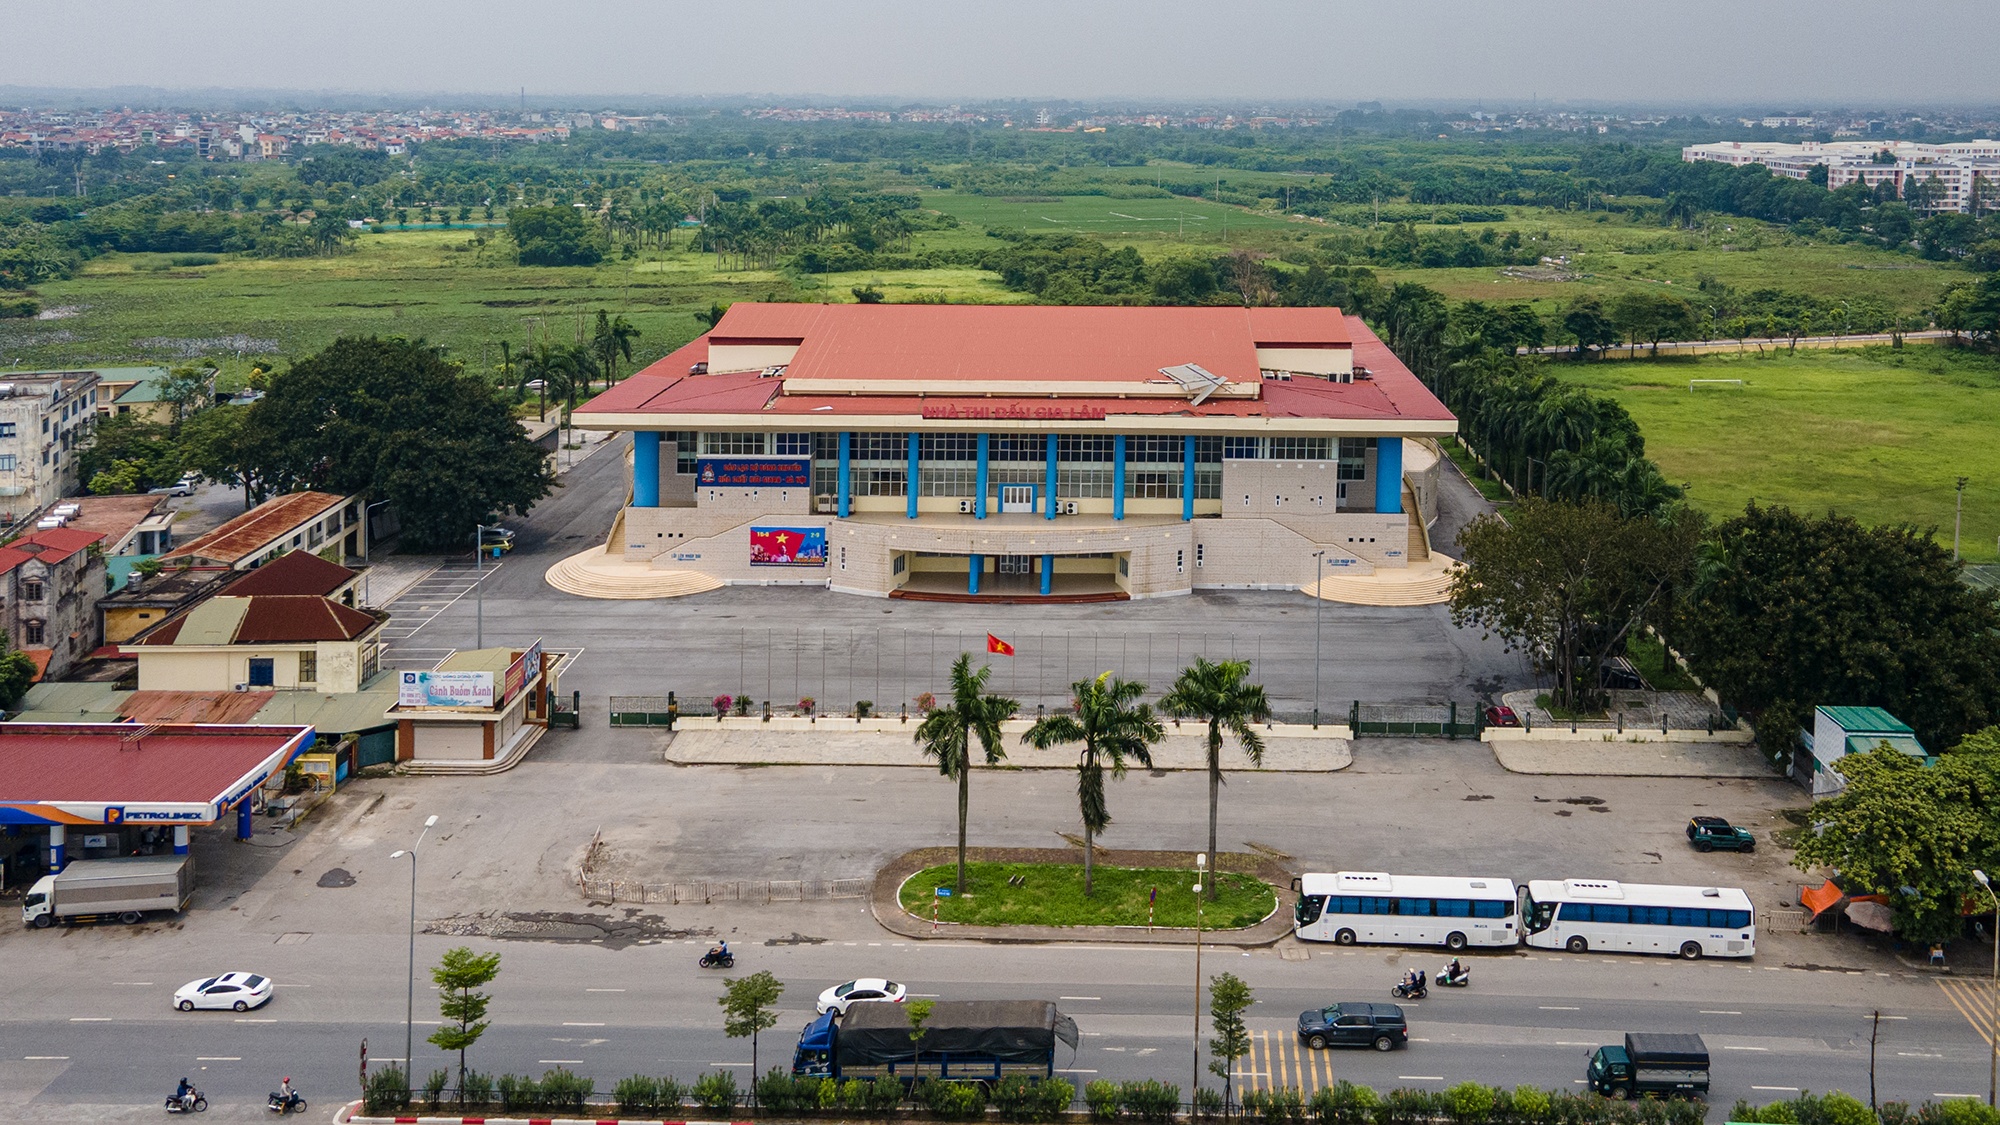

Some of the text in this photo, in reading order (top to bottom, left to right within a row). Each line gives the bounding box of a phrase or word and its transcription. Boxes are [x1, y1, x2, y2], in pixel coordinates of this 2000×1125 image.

[923, 402, 1105, 418] NHÀ THI ĐẤU GIA LÂM
[472, 685, 491, 696] Xanh
